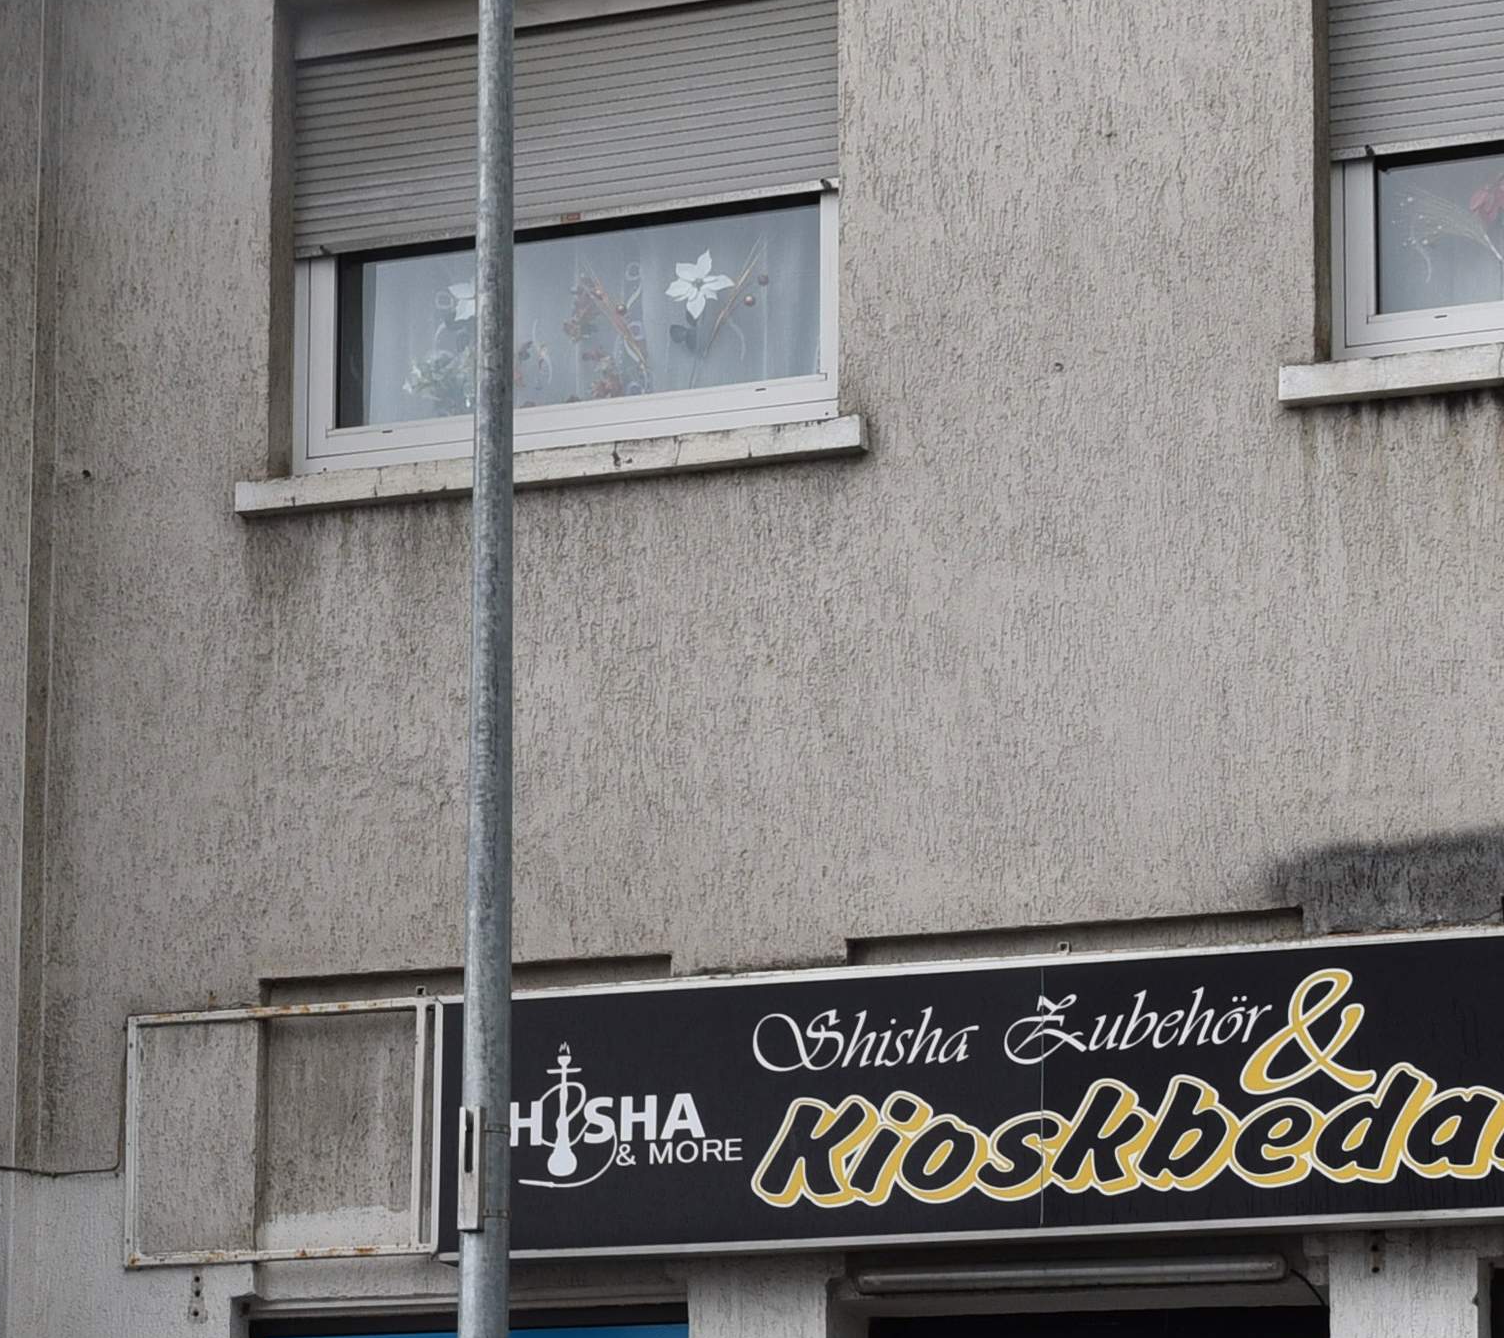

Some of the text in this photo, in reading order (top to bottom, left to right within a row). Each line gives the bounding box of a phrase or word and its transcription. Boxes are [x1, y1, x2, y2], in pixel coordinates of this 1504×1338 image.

[752, 987, 1273, 1073] Shisha Zubehör
[1240, 967, 1377, 1095] &
[615, 1137, 744, 1167] & MORE
